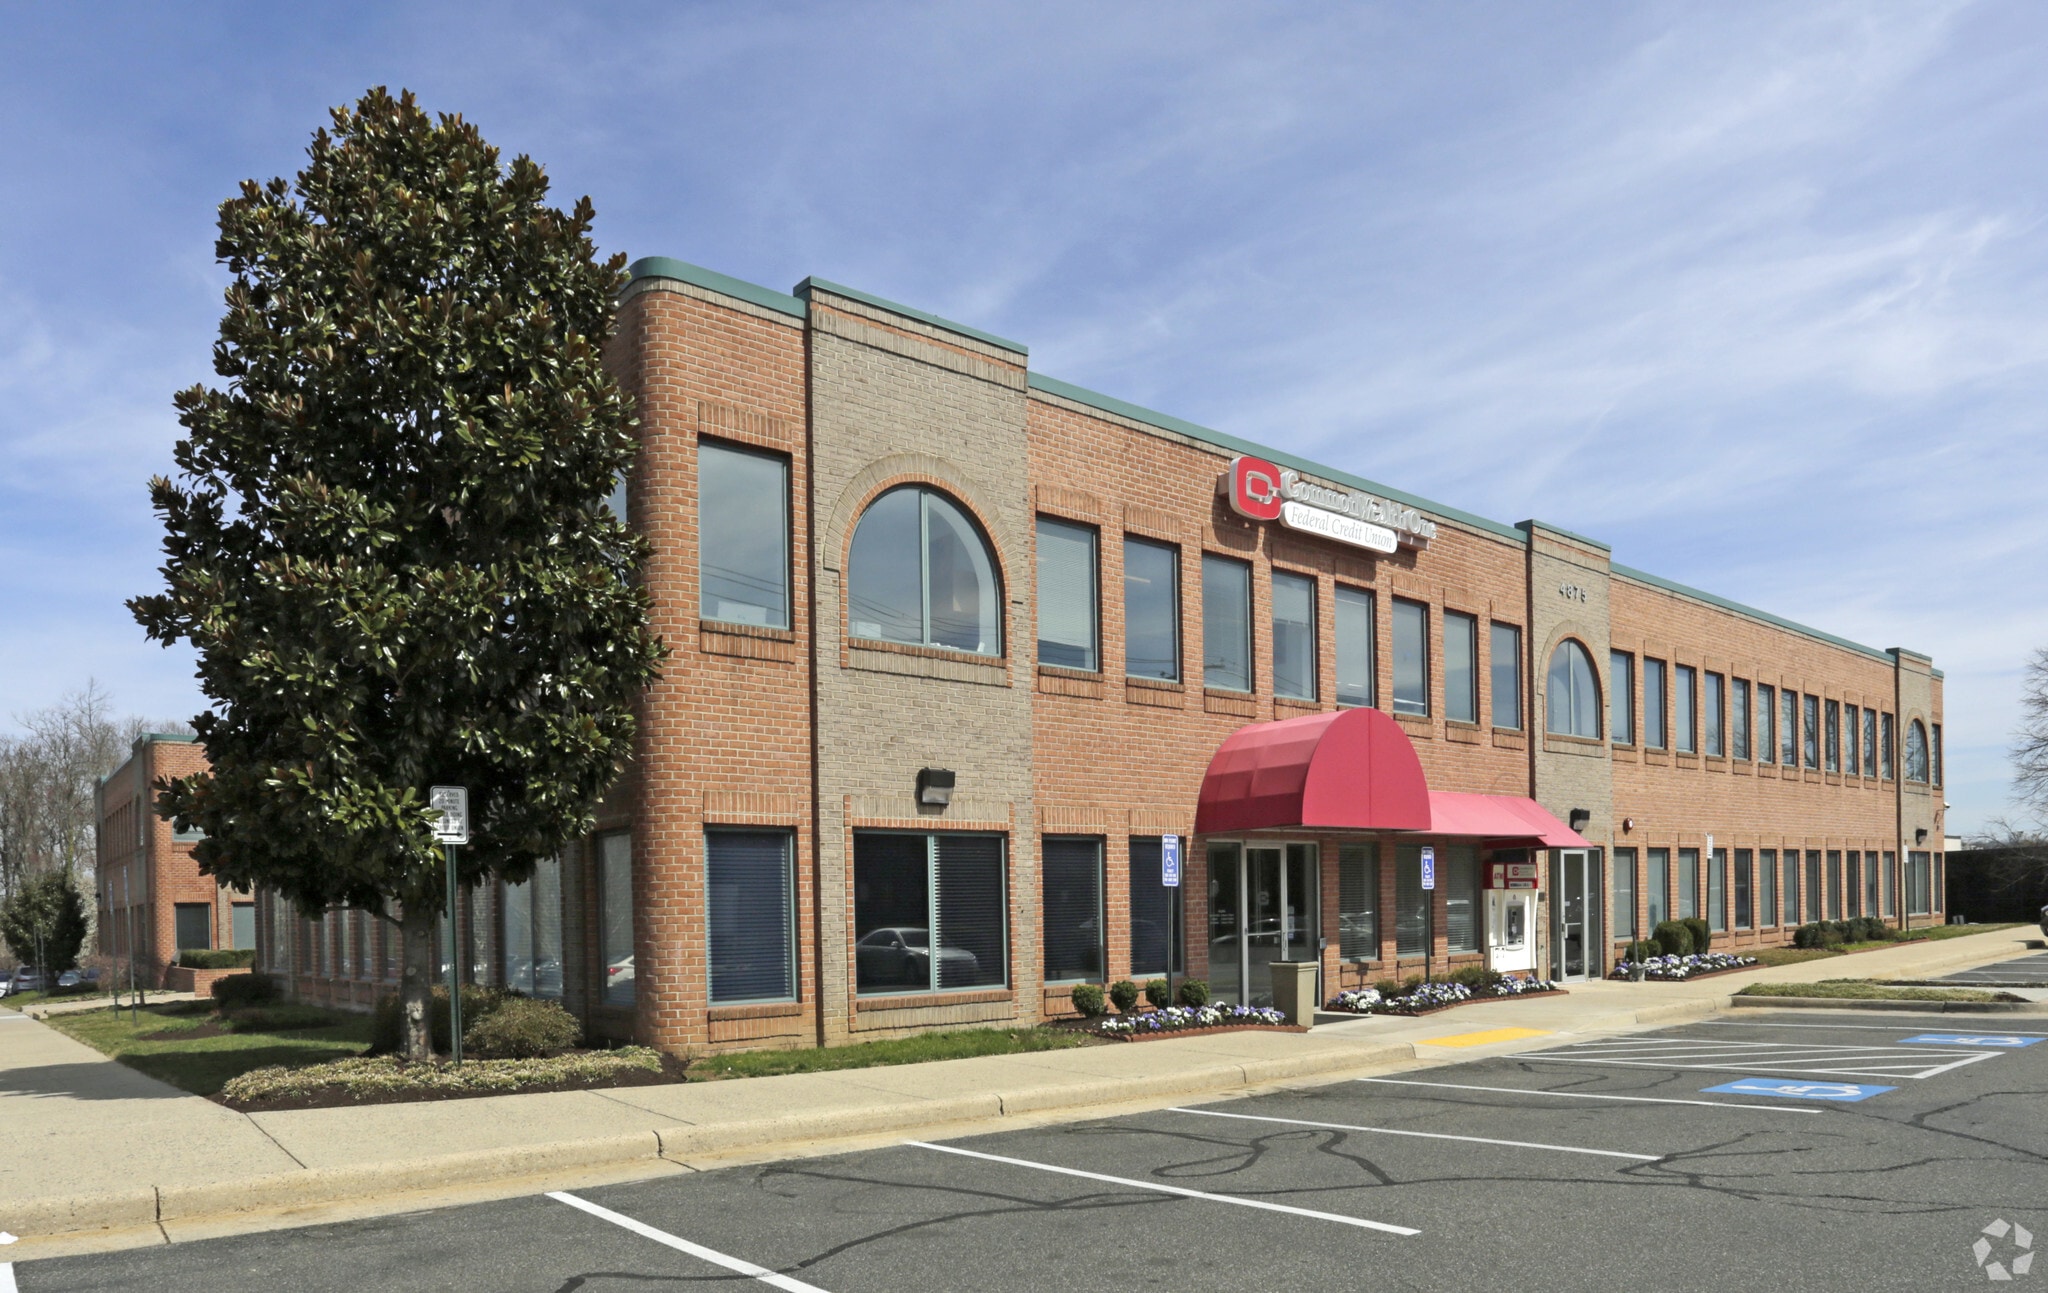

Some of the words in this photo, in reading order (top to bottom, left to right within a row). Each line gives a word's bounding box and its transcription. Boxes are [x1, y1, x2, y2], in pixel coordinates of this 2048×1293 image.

[1291, 506, 1329, 531] Federal
[1331, 519, 1362, 541] Credit
[1365, 527, 1392, 549] Union
[1404, 509, 1437, 539] One
